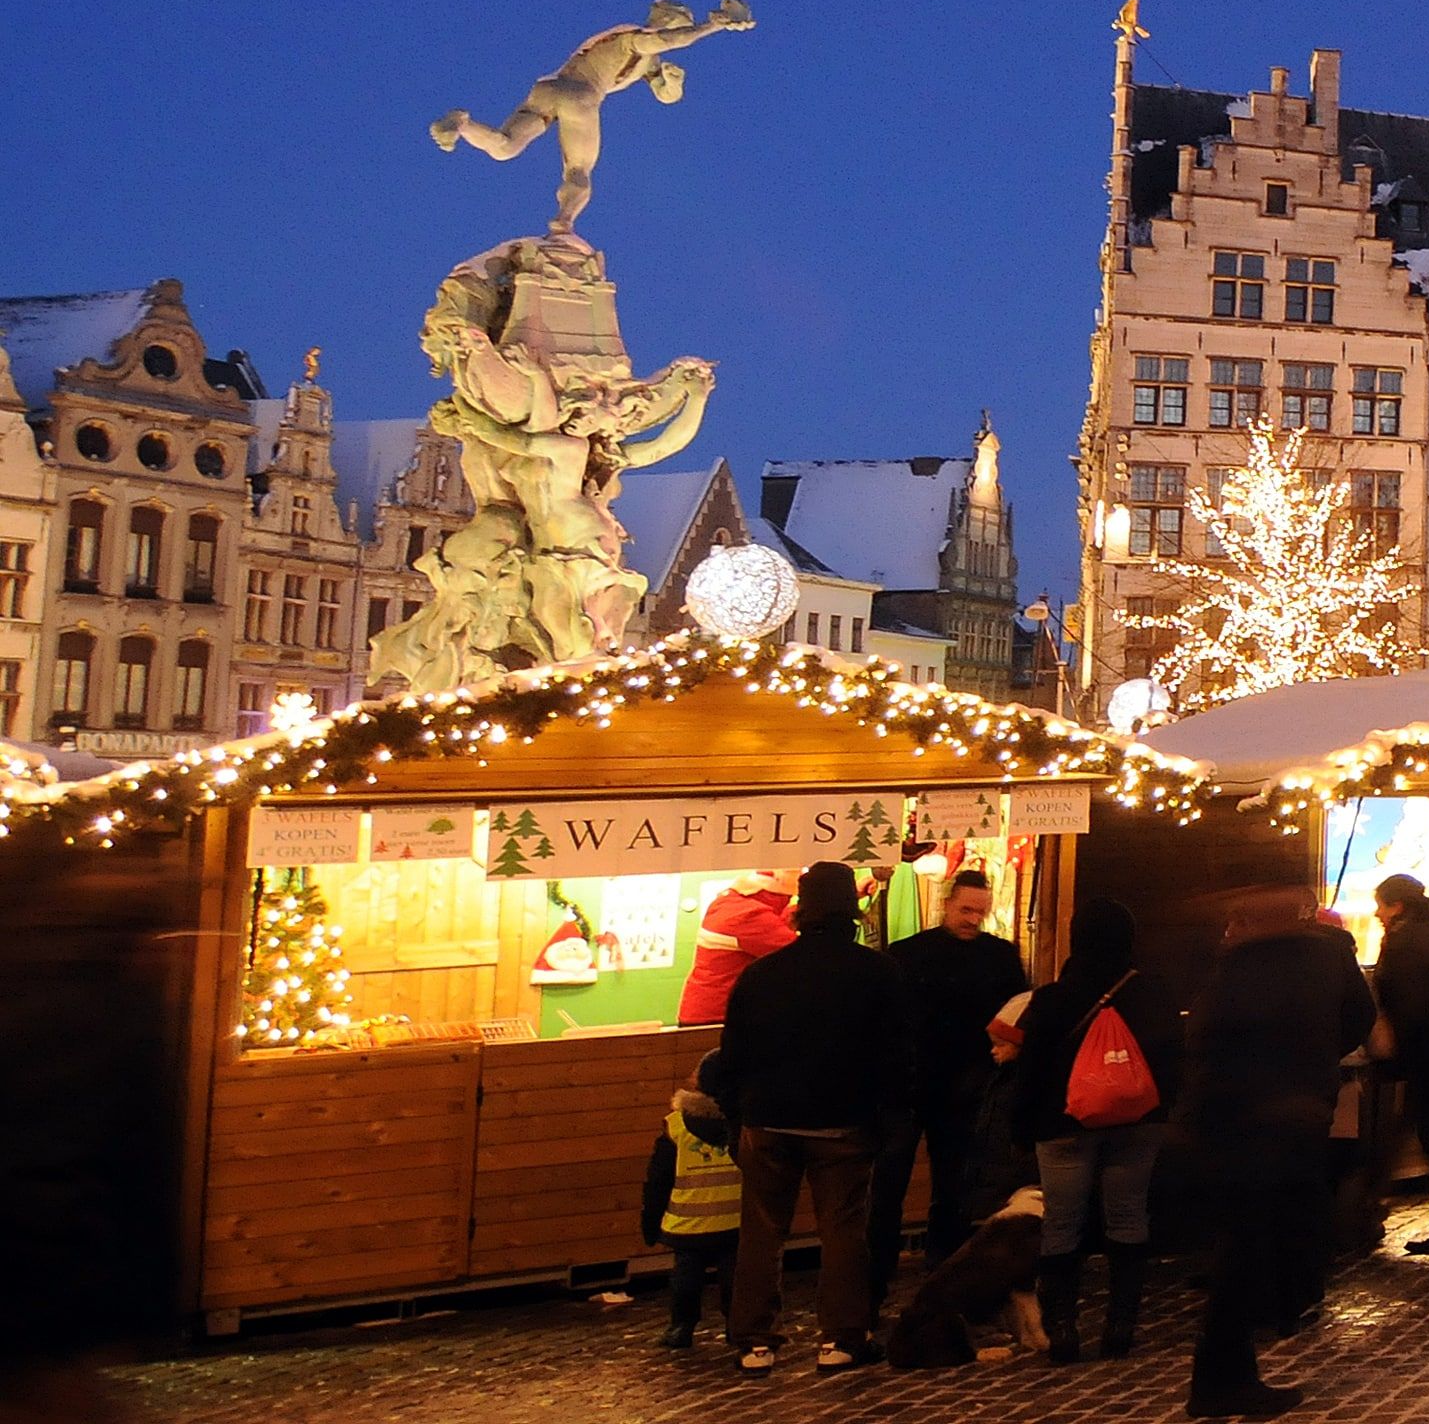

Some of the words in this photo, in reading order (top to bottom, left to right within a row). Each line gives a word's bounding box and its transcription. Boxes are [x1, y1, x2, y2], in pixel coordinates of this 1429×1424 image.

[1025, 801, 1073, 814] KOPEN
[277, 811, 353, 824] WAFELS
[273, 828, 339, 842] KOPEN
[565, 811, 838, 851] WAFELS
[276, 844, 353, 859] GRATIS!
